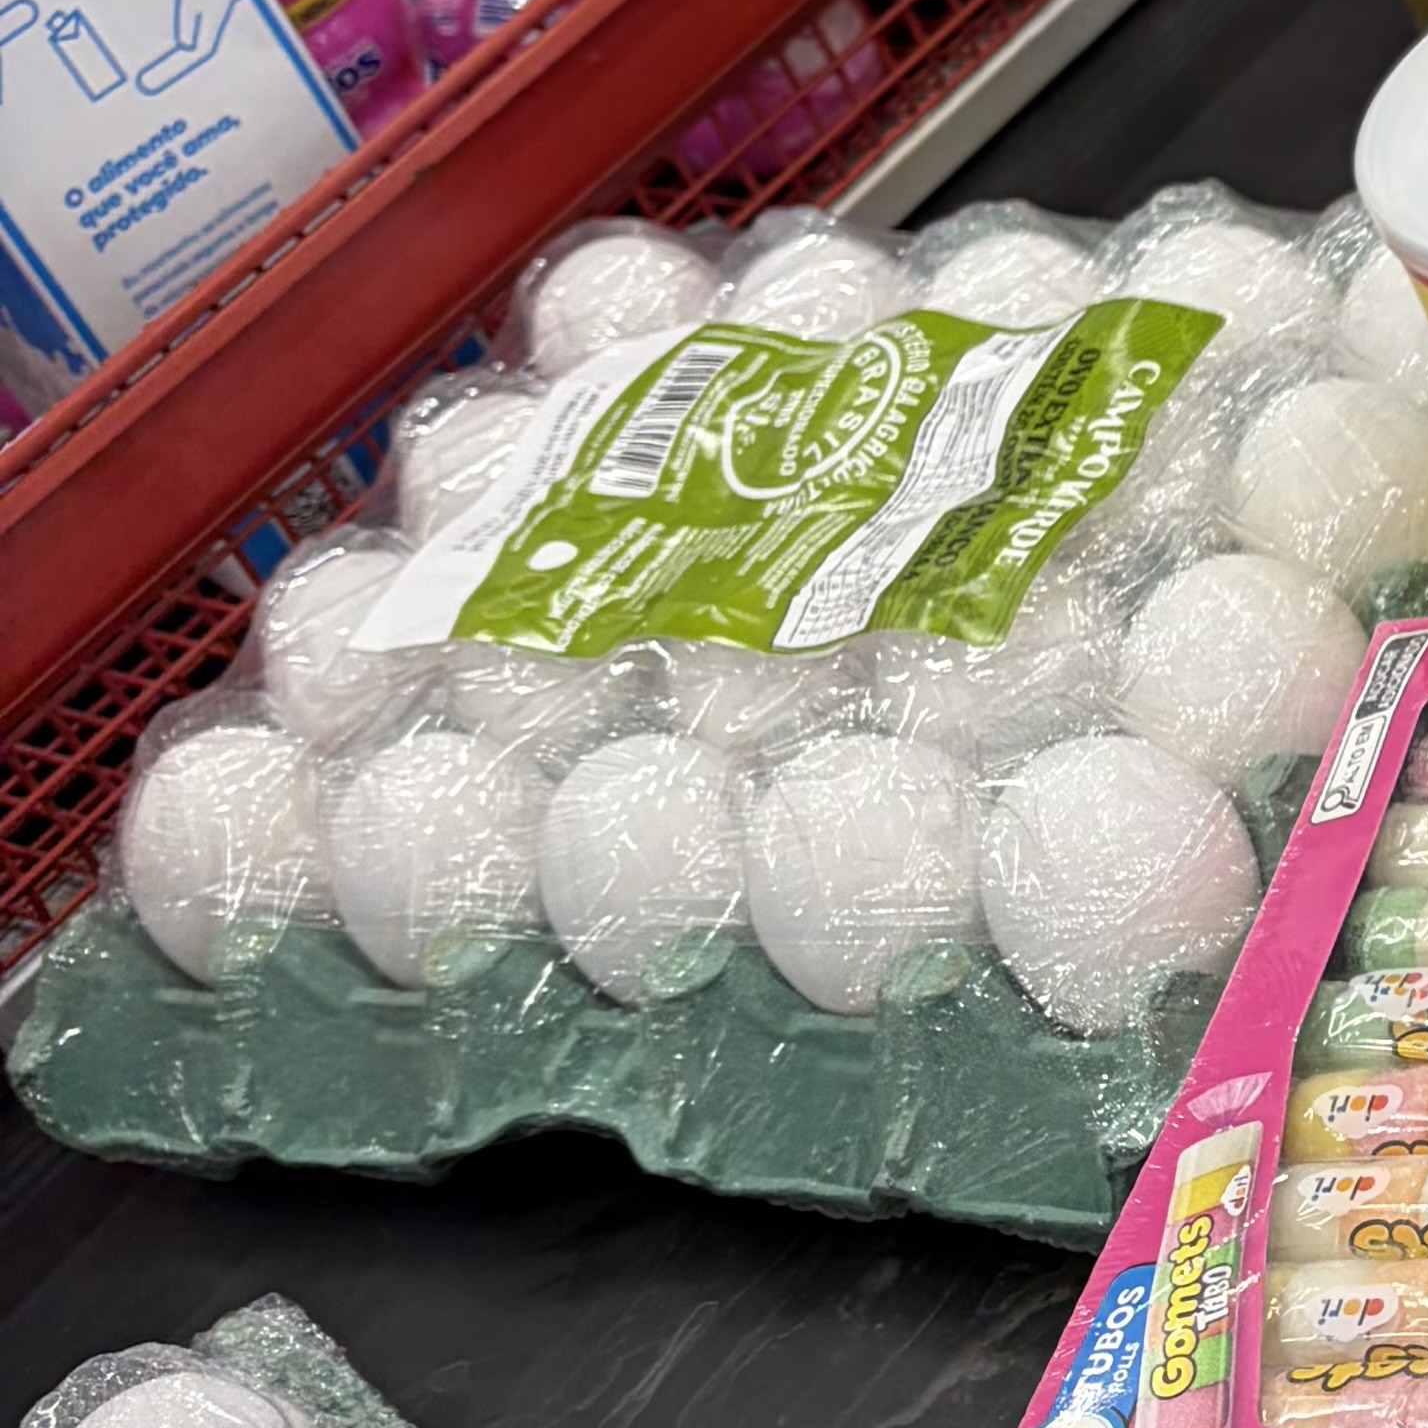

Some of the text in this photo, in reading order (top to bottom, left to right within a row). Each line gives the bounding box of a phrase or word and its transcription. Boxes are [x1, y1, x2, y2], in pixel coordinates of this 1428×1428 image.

[78, 115, 241, 230] que você ama,
[87, 119, 188, 195] alimento
[91, 166, 209, 255] protegido.
[802, 346, 887, 461] BRASIL
[994, 359, 1161, 567] CAMPO VERDE
[1072, 1285, 1146, 1414] TUBOS
[1150, 1214, 1214, 1400] Gomets
[1108, 1341, 1140, 1395] ROLLS
